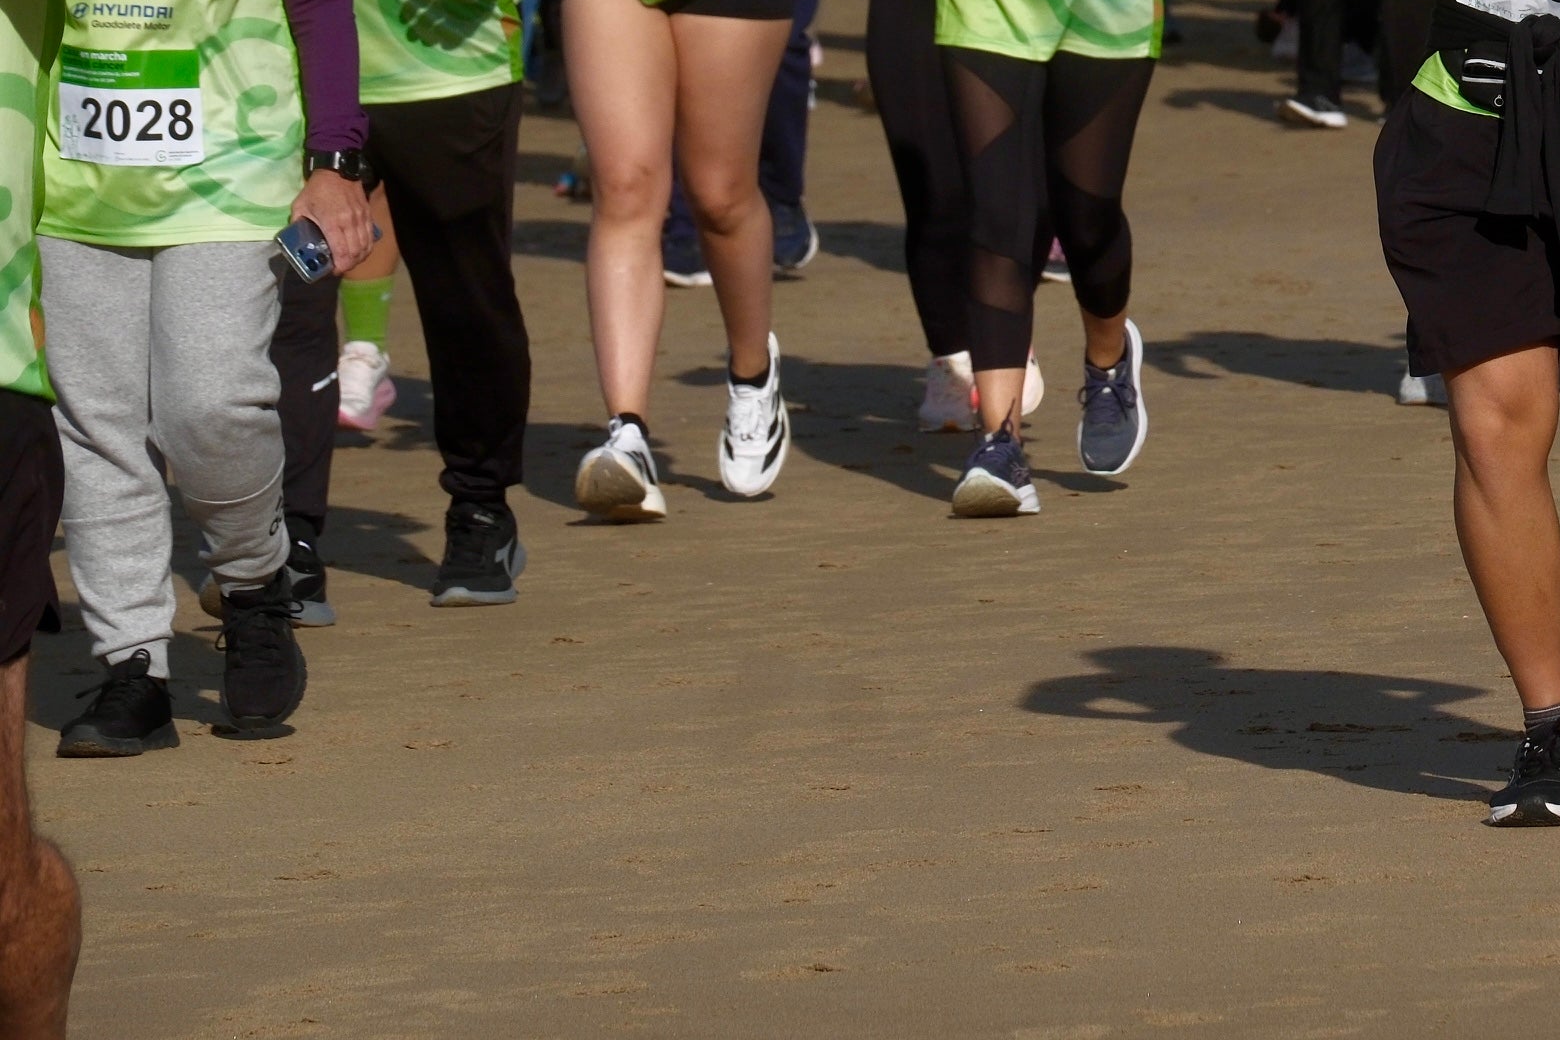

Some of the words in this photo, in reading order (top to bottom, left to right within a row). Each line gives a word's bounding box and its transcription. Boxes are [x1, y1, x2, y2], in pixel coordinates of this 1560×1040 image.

[93, 3, 174, 18] HYUNDAI
[91, 20, 141, 30] Guadalete
[144, 22, 170, 30] Motor
[90, 52, 127, 61] marcha
[81, 97, 194, 142] 2028
